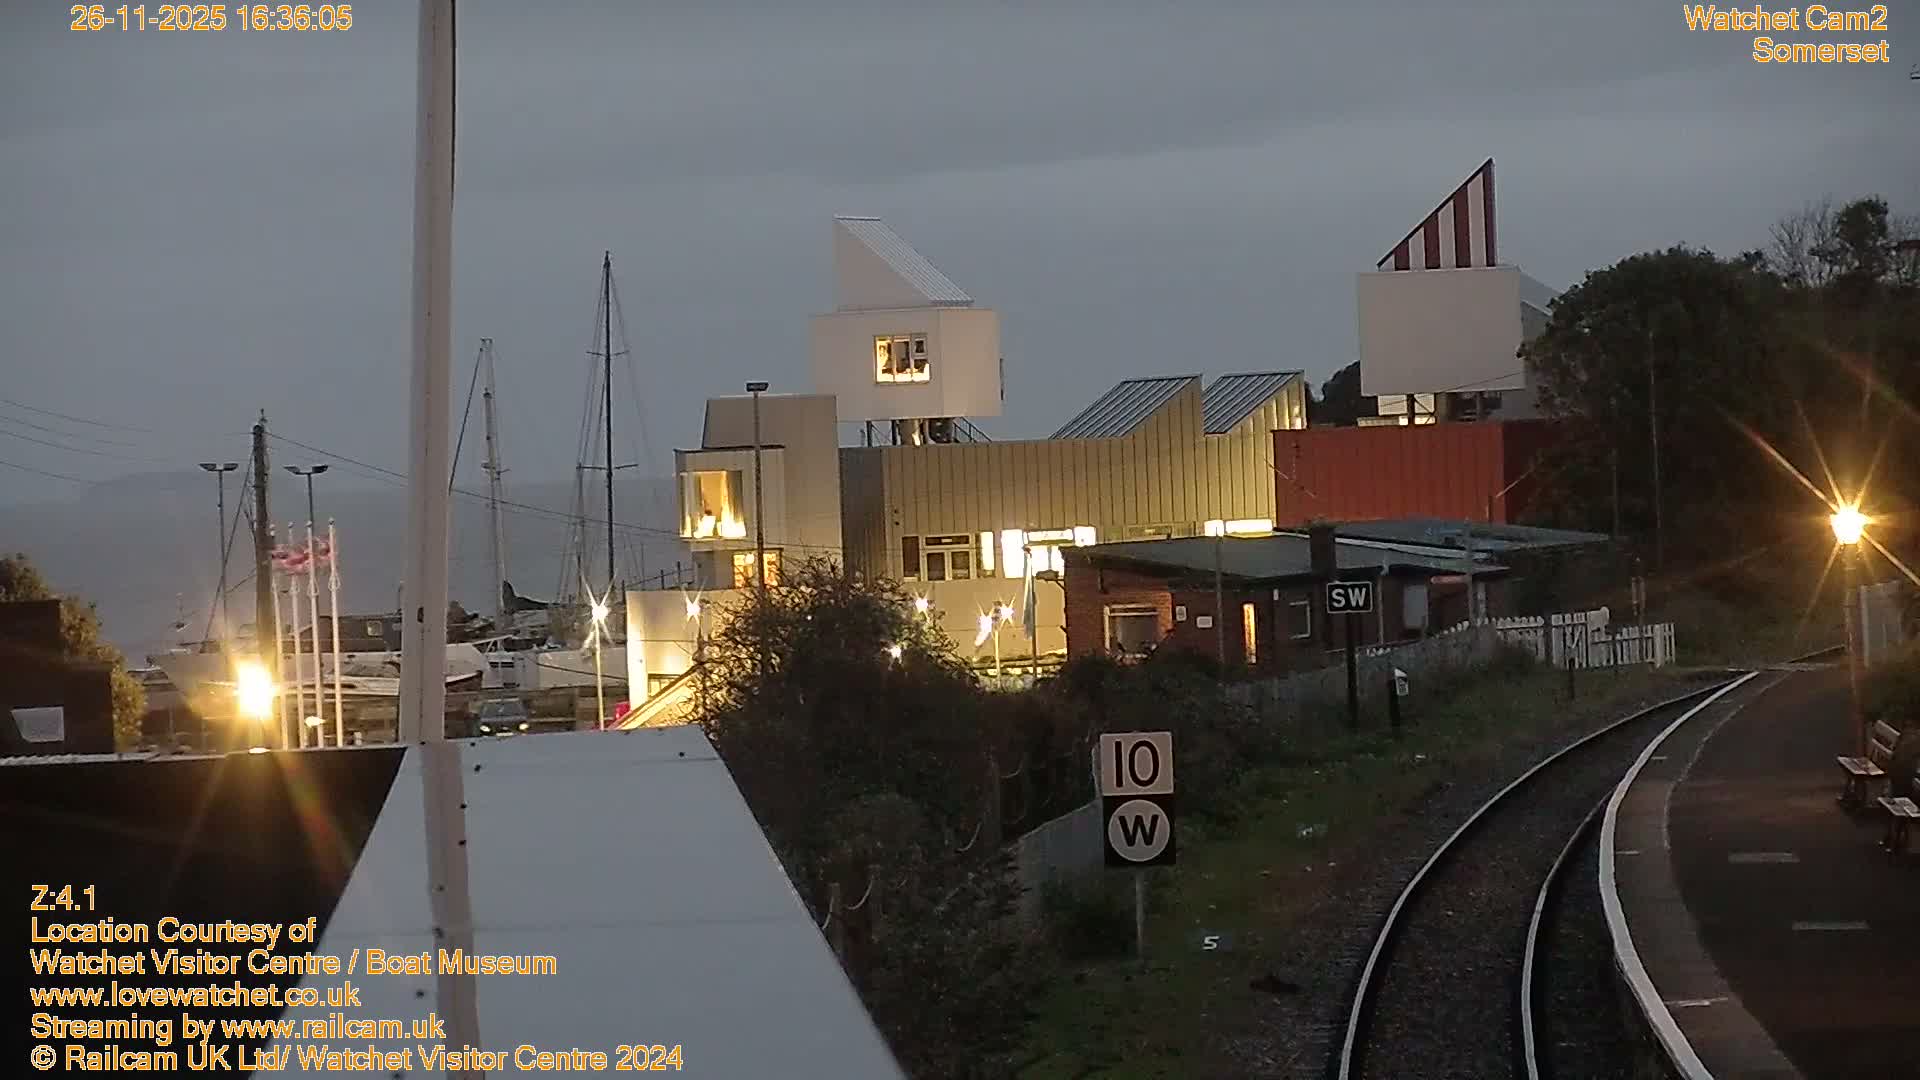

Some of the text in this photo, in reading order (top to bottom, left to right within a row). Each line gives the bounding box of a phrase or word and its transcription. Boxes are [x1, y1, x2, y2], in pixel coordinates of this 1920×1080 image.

[1331, 587, 1367, 608] SW
[1114, 740, 1160, 788] 10
[1118, 814, 1159, 847] W
